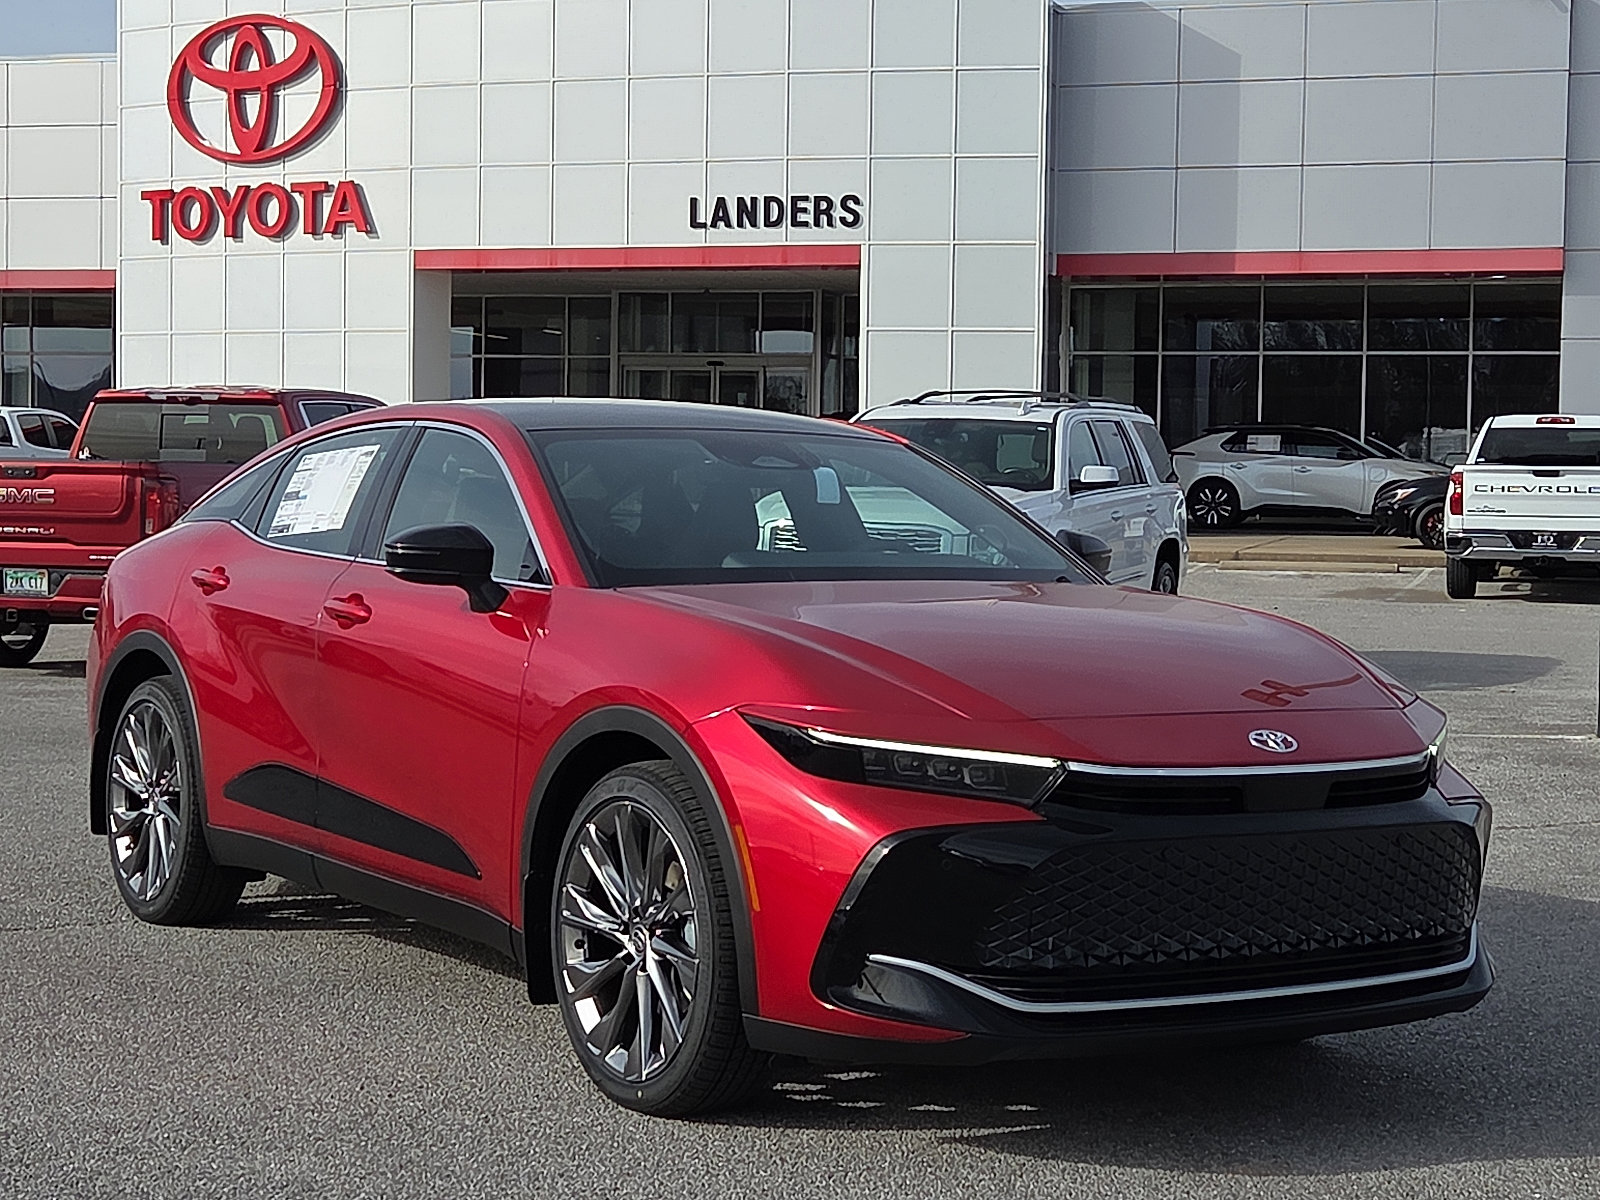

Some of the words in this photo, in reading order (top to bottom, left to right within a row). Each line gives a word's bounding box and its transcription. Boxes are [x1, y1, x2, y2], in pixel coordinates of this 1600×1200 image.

[141, 180, 371, 242] TOYOTA
[689, 194, 862, 229] LANDERS
[0, 527, 55, 535] ENALI
